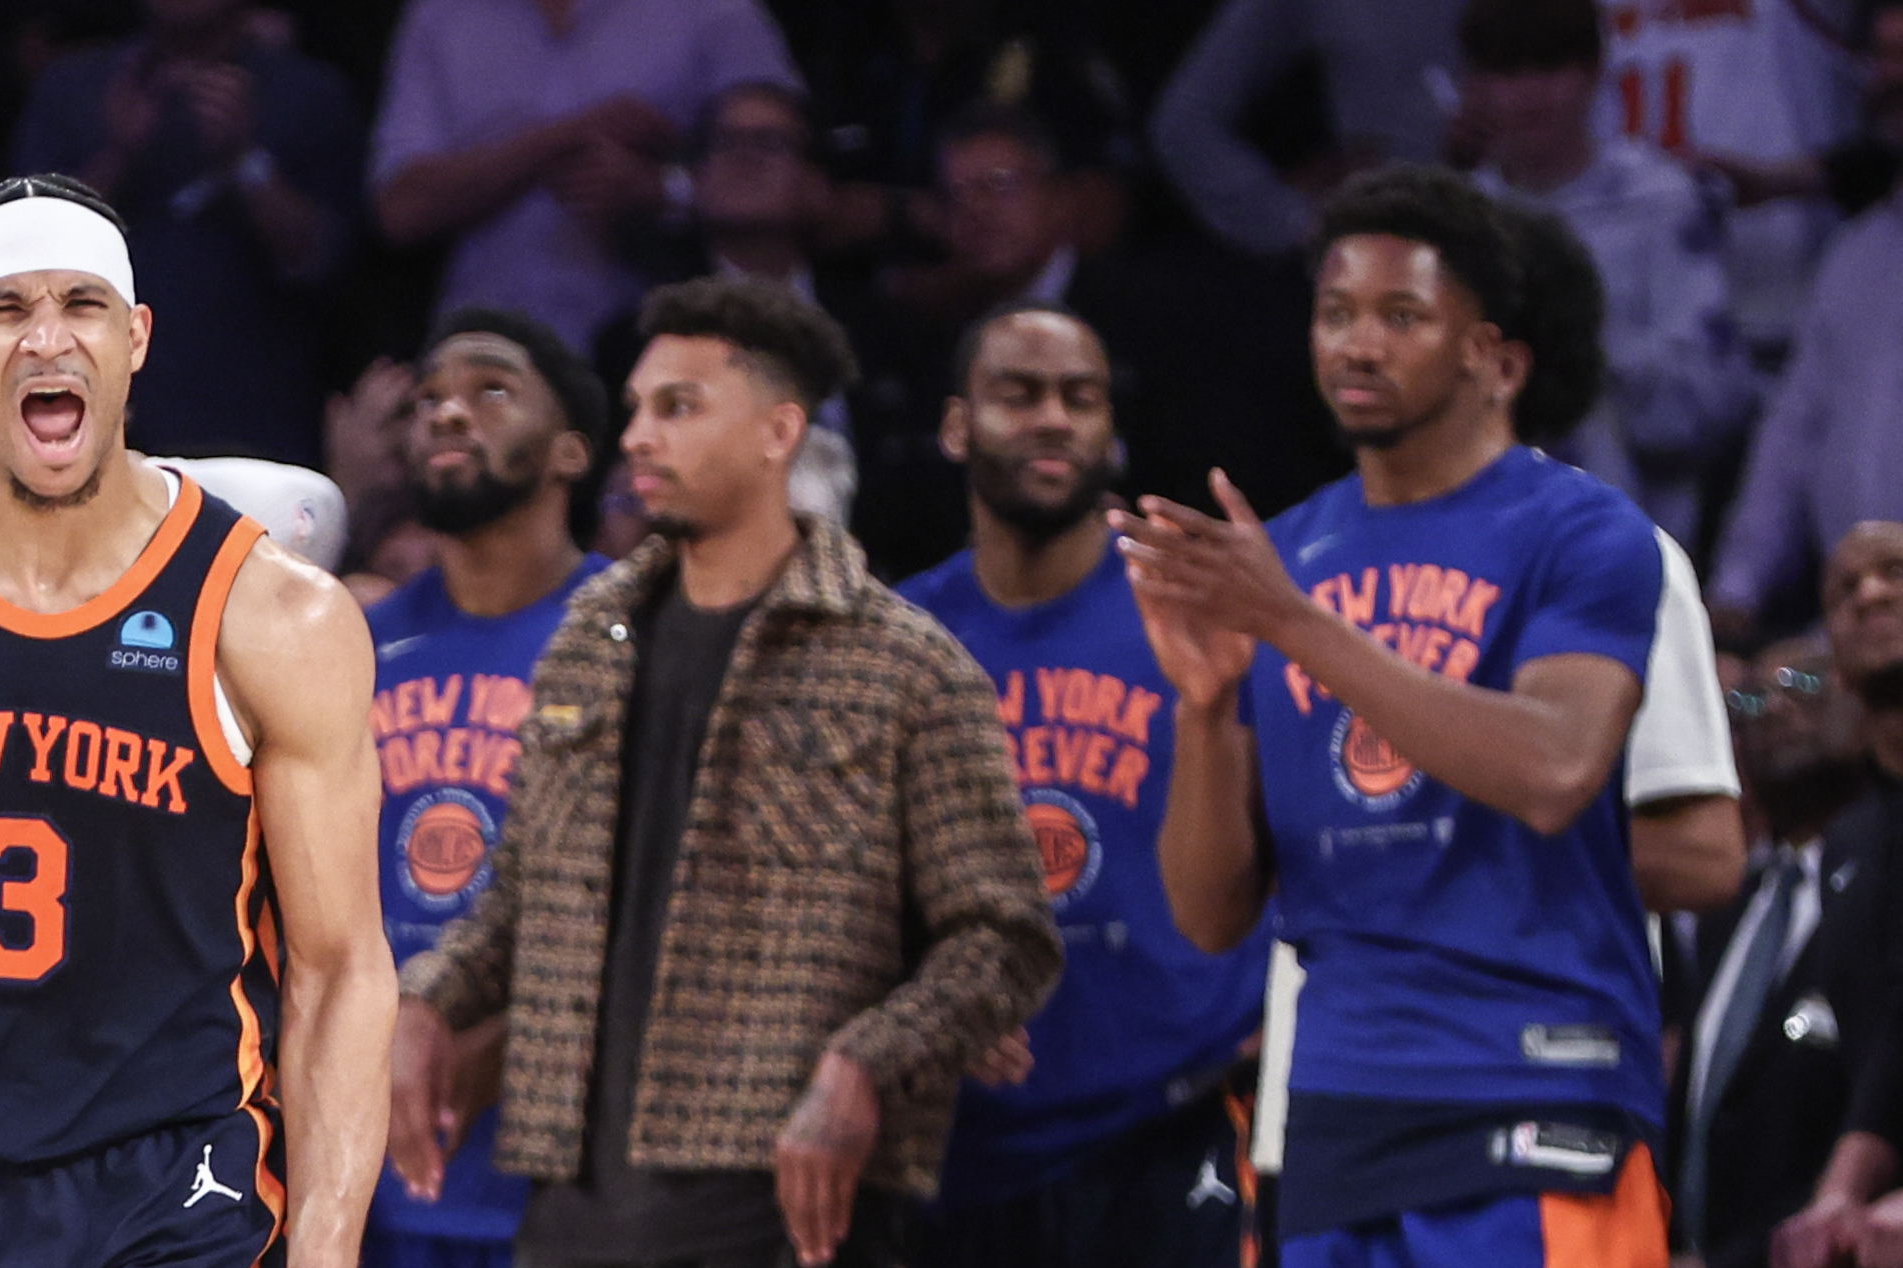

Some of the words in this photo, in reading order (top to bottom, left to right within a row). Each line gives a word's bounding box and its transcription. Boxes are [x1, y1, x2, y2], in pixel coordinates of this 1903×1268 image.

[1389, 562, 1502, 640] YORK
[110, 650, 178, 671] sphere
[369, 673, 464, 740] NEW
[1035, 667, 1163, 745] YORK
[22, 711, 196, 815] YORK
